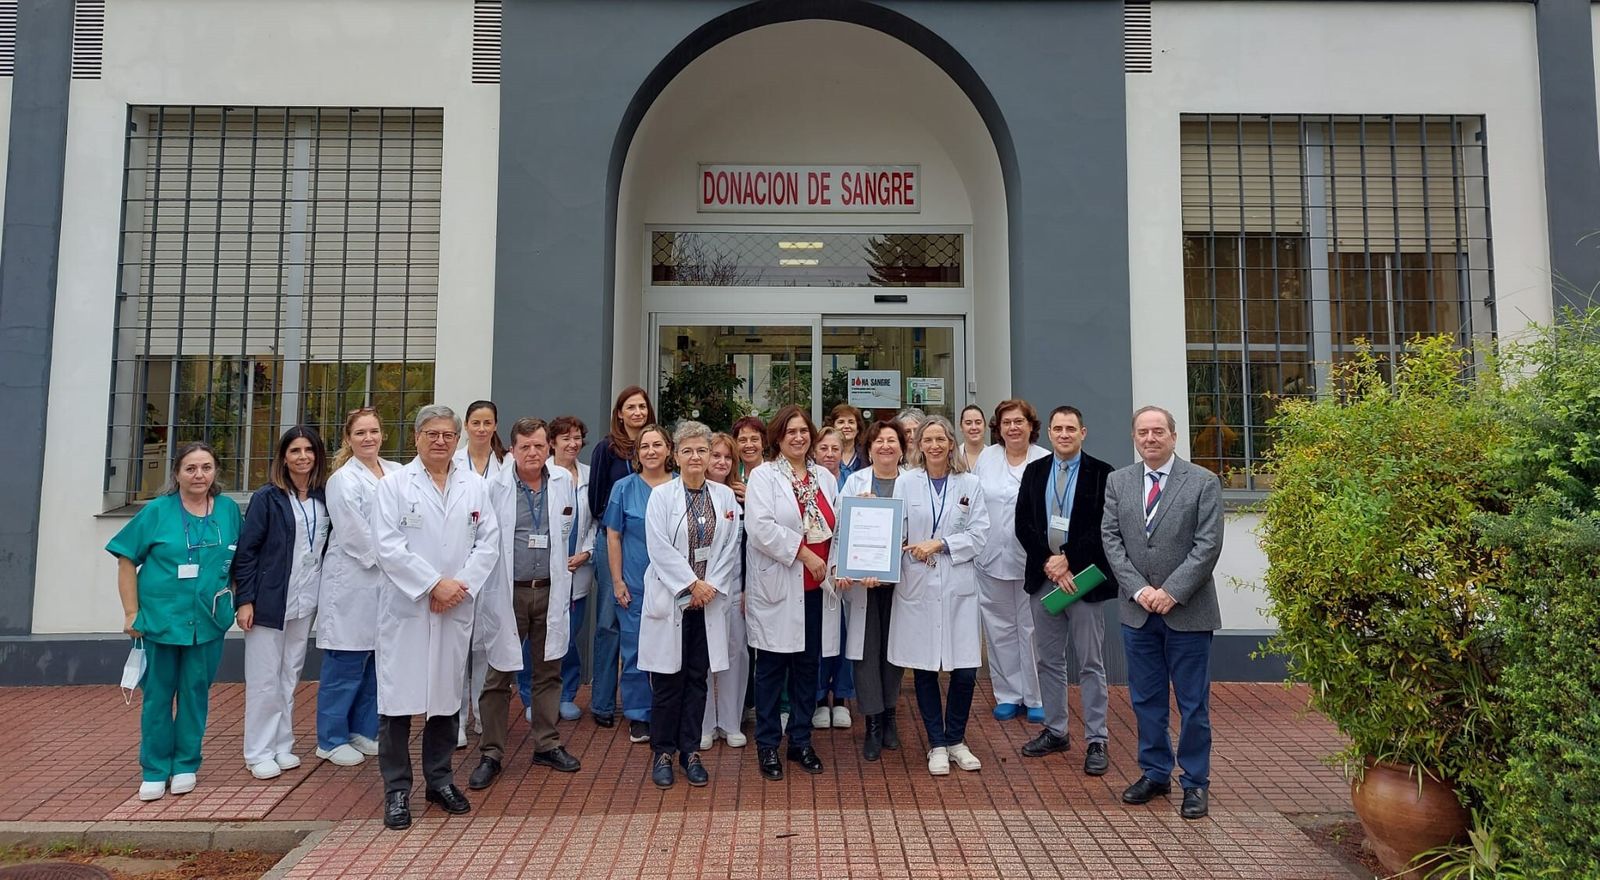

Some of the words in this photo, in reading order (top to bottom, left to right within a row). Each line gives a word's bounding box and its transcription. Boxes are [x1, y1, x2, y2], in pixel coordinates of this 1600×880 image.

[703, 171, 799, 206] DONACION
[807, 172, 831, 206] DE
[841, 171, 914, 206] SANGRE
[870, 378, 891, 387] SANGRE
